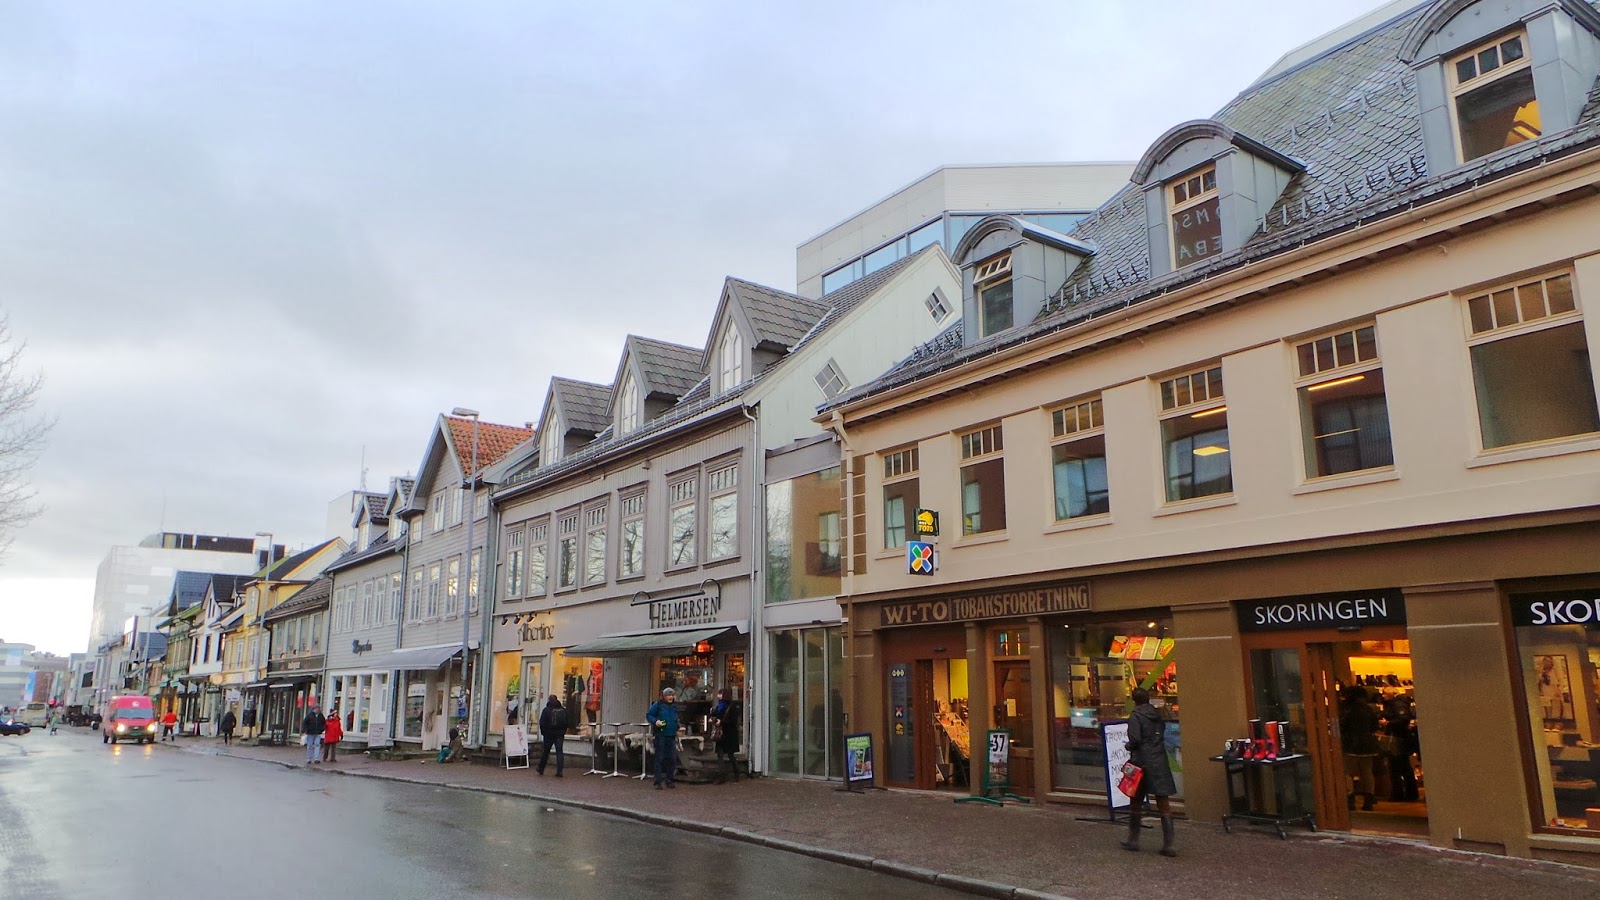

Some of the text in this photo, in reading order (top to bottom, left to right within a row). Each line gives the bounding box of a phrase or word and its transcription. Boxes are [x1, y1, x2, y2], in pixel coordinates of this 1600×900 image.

[650, 596, 719, 629] HELMERSEN
[883, 585, 1087, 625] WI-TO TOBAKSFORRETNING
[1254, 597, 1388, 625] SKORINGEN
